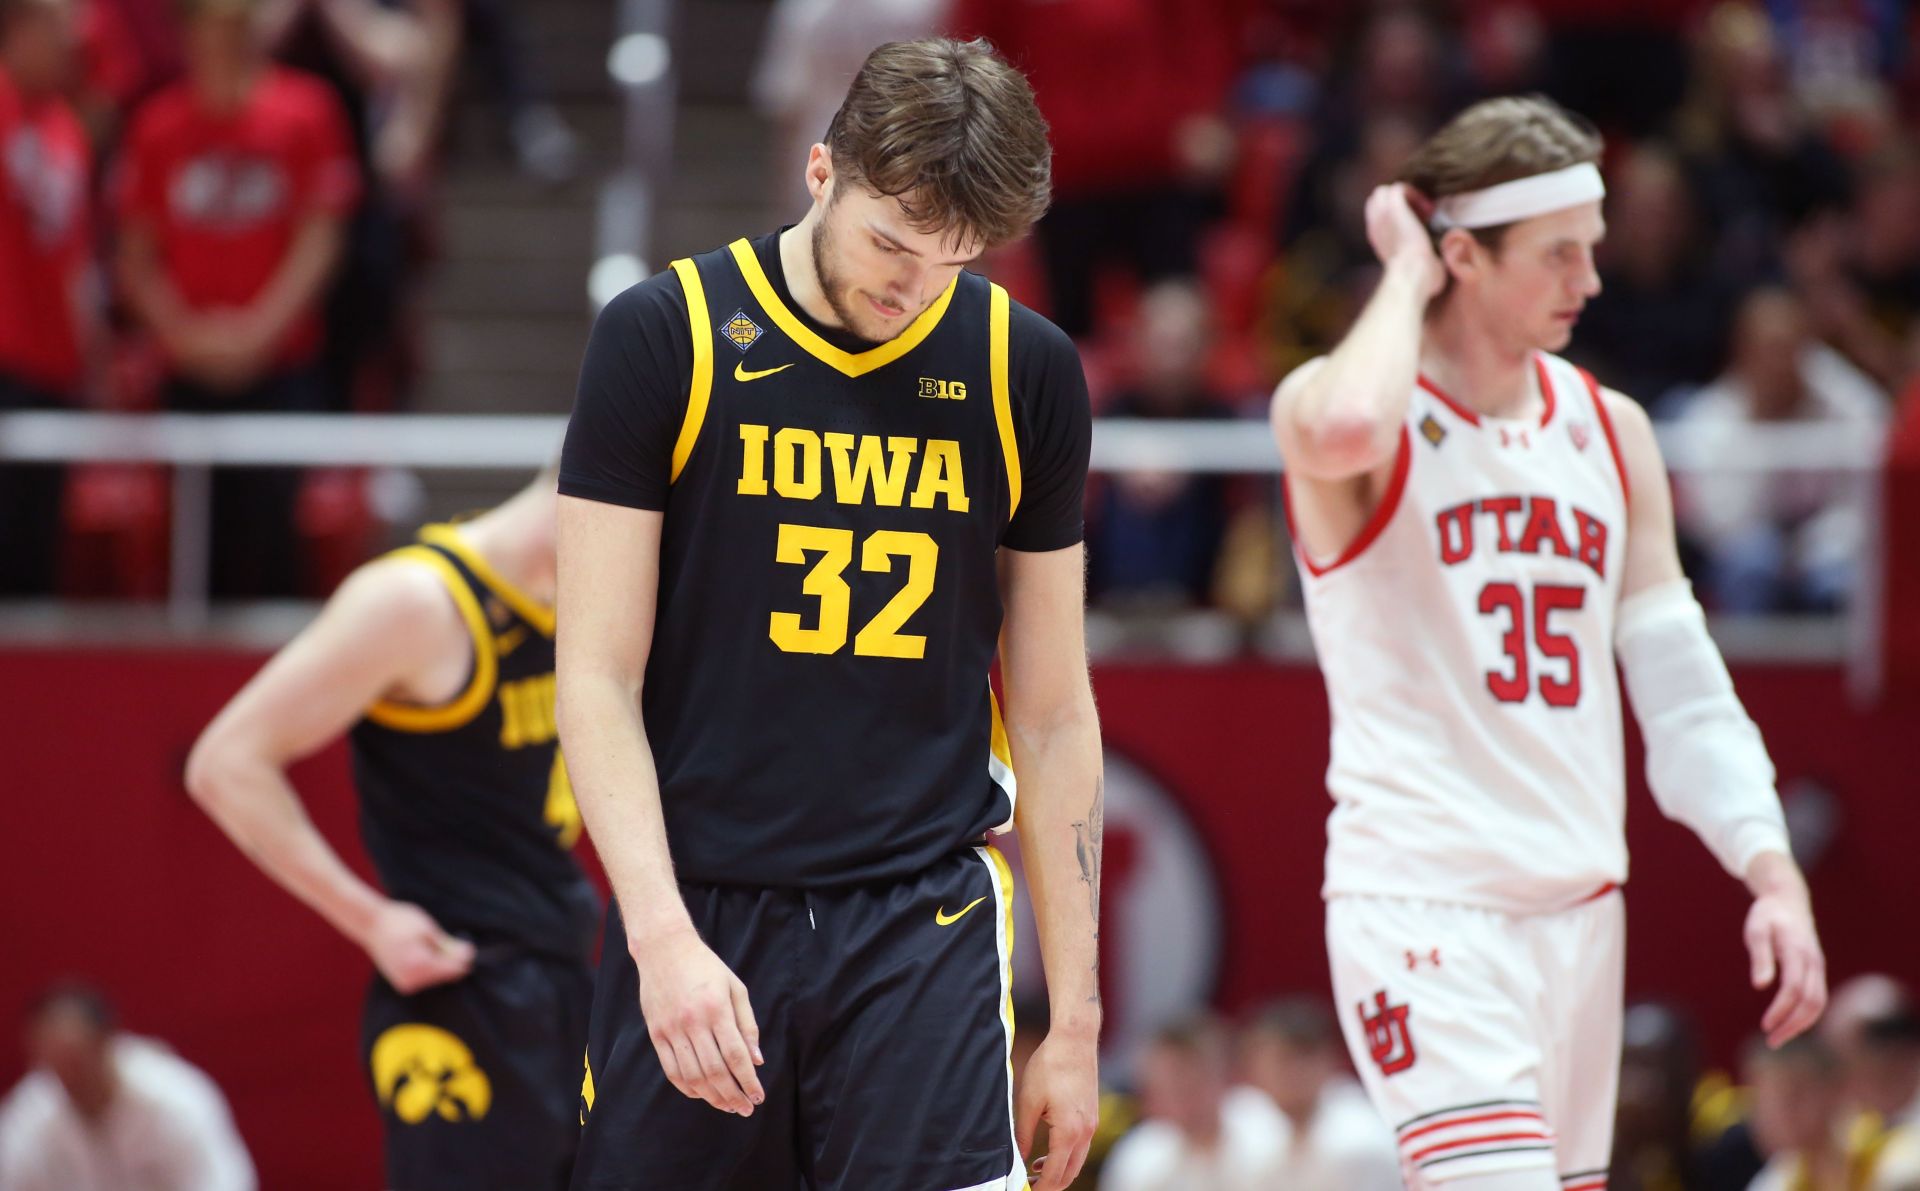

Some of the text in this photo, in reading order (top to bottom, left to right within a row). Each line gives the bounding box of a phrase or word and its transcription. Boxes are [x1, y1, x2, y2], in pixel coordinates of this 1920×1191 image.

[737, 423, 970, 513] IOWA
[769, 523, 939, 659] 32
[1436, 495, 1608, 580] UTAH
[1478, 582, 1586, 707] 35
